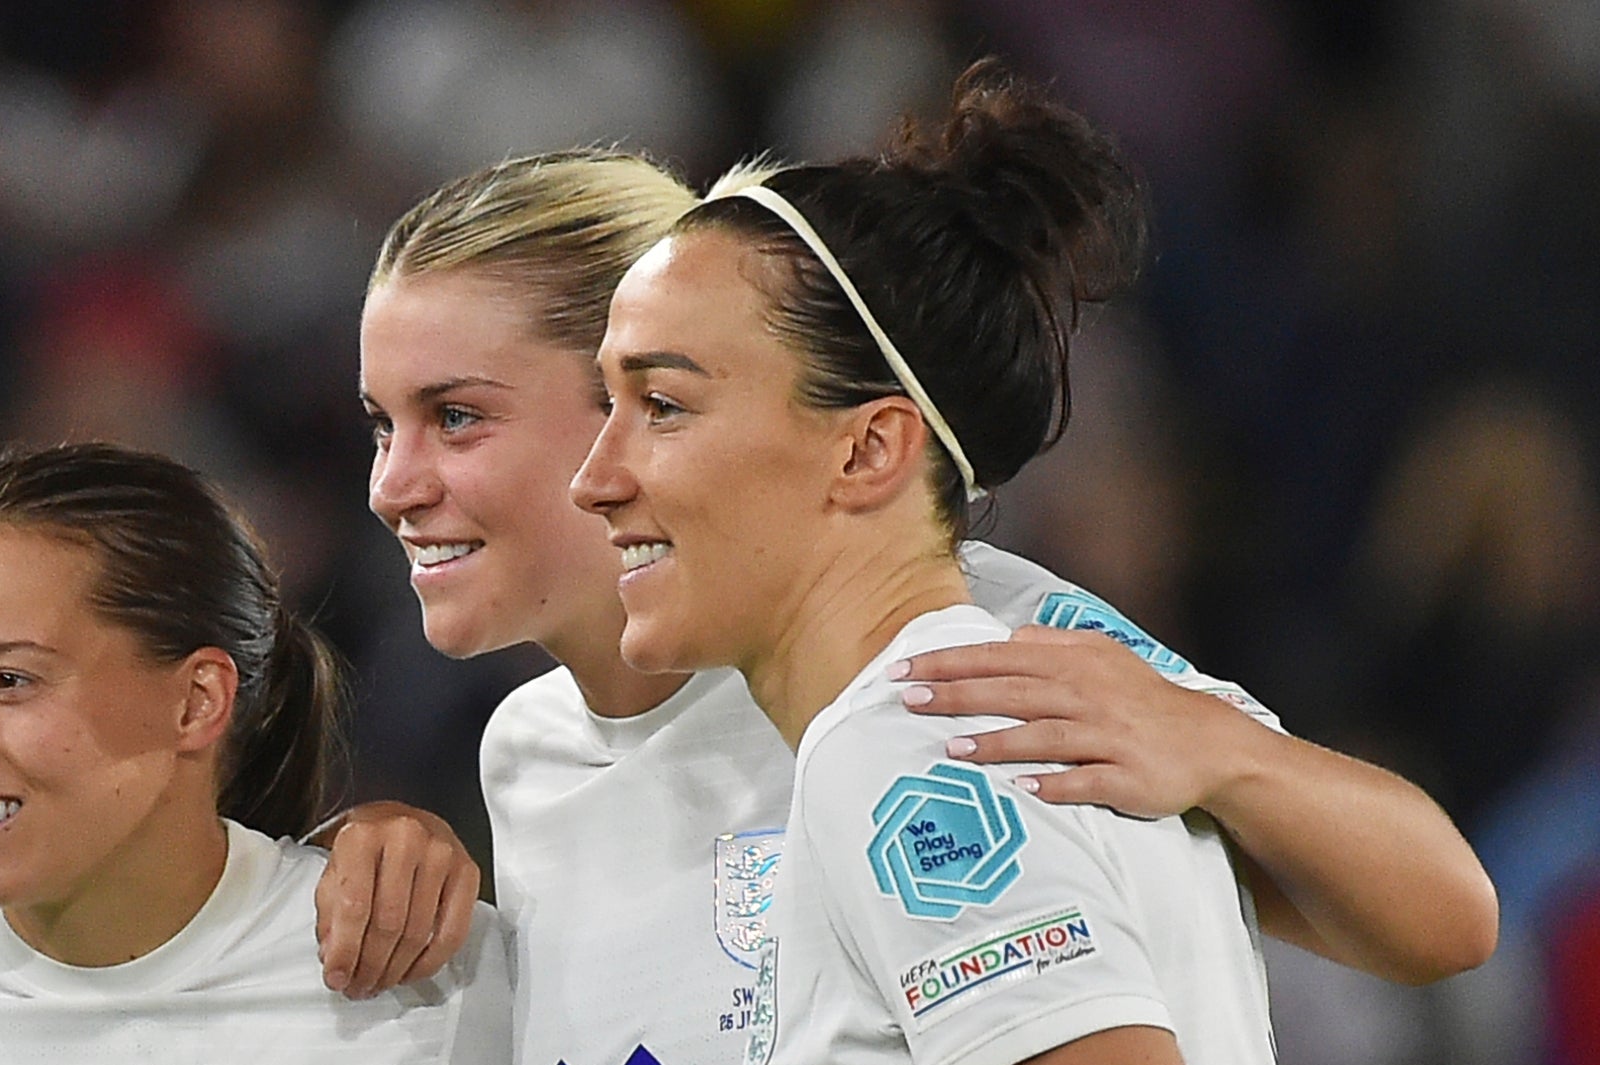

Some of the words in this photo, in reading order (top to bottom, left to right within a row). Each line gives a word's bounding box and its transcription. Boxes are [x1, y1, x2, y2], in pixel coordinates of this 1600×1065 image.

[906, 820, 936, 837] We
[914, 833, 955, 856] Play
[920, 843, 984, 872] Strong
[1036, 959, 1051, 974] for
[1055, 946, 1097, 965] children
[900, 959, 937, 988] UEFA
[719, 1013, 734, 1031] 26
